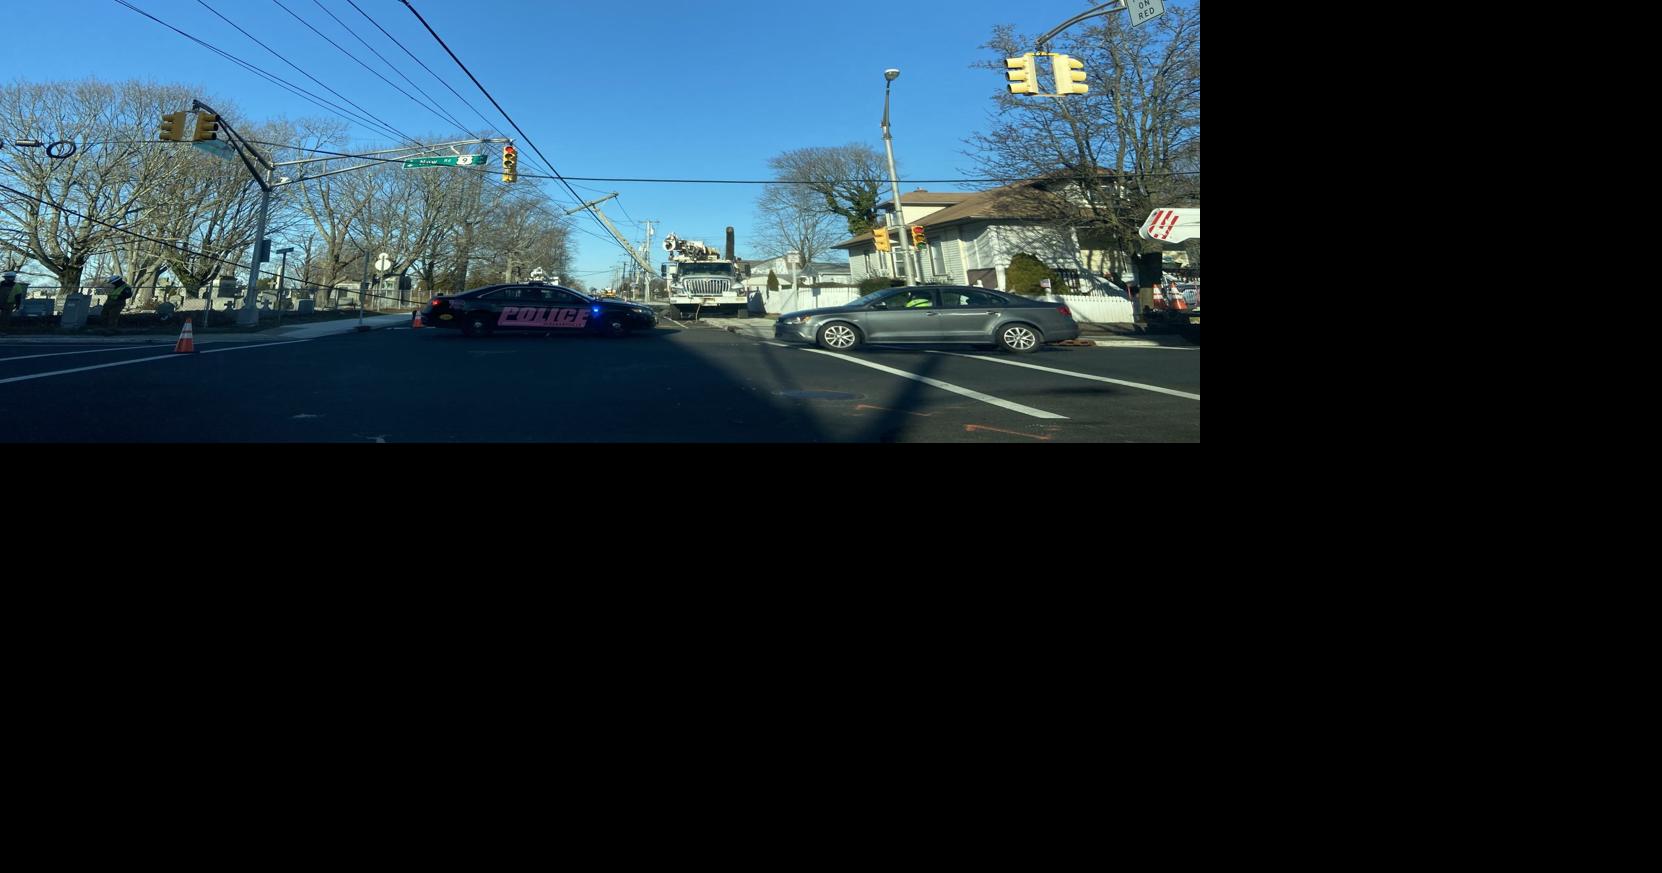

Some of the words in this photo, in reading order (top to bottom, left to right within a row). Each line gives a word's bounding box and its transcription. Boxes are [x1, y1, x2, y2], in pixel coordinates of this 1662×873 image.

[1138, 0, 1150, 9] ON
[1138, 7, 1155, 20] RED
[497, 306, 591, 328] POLICE
